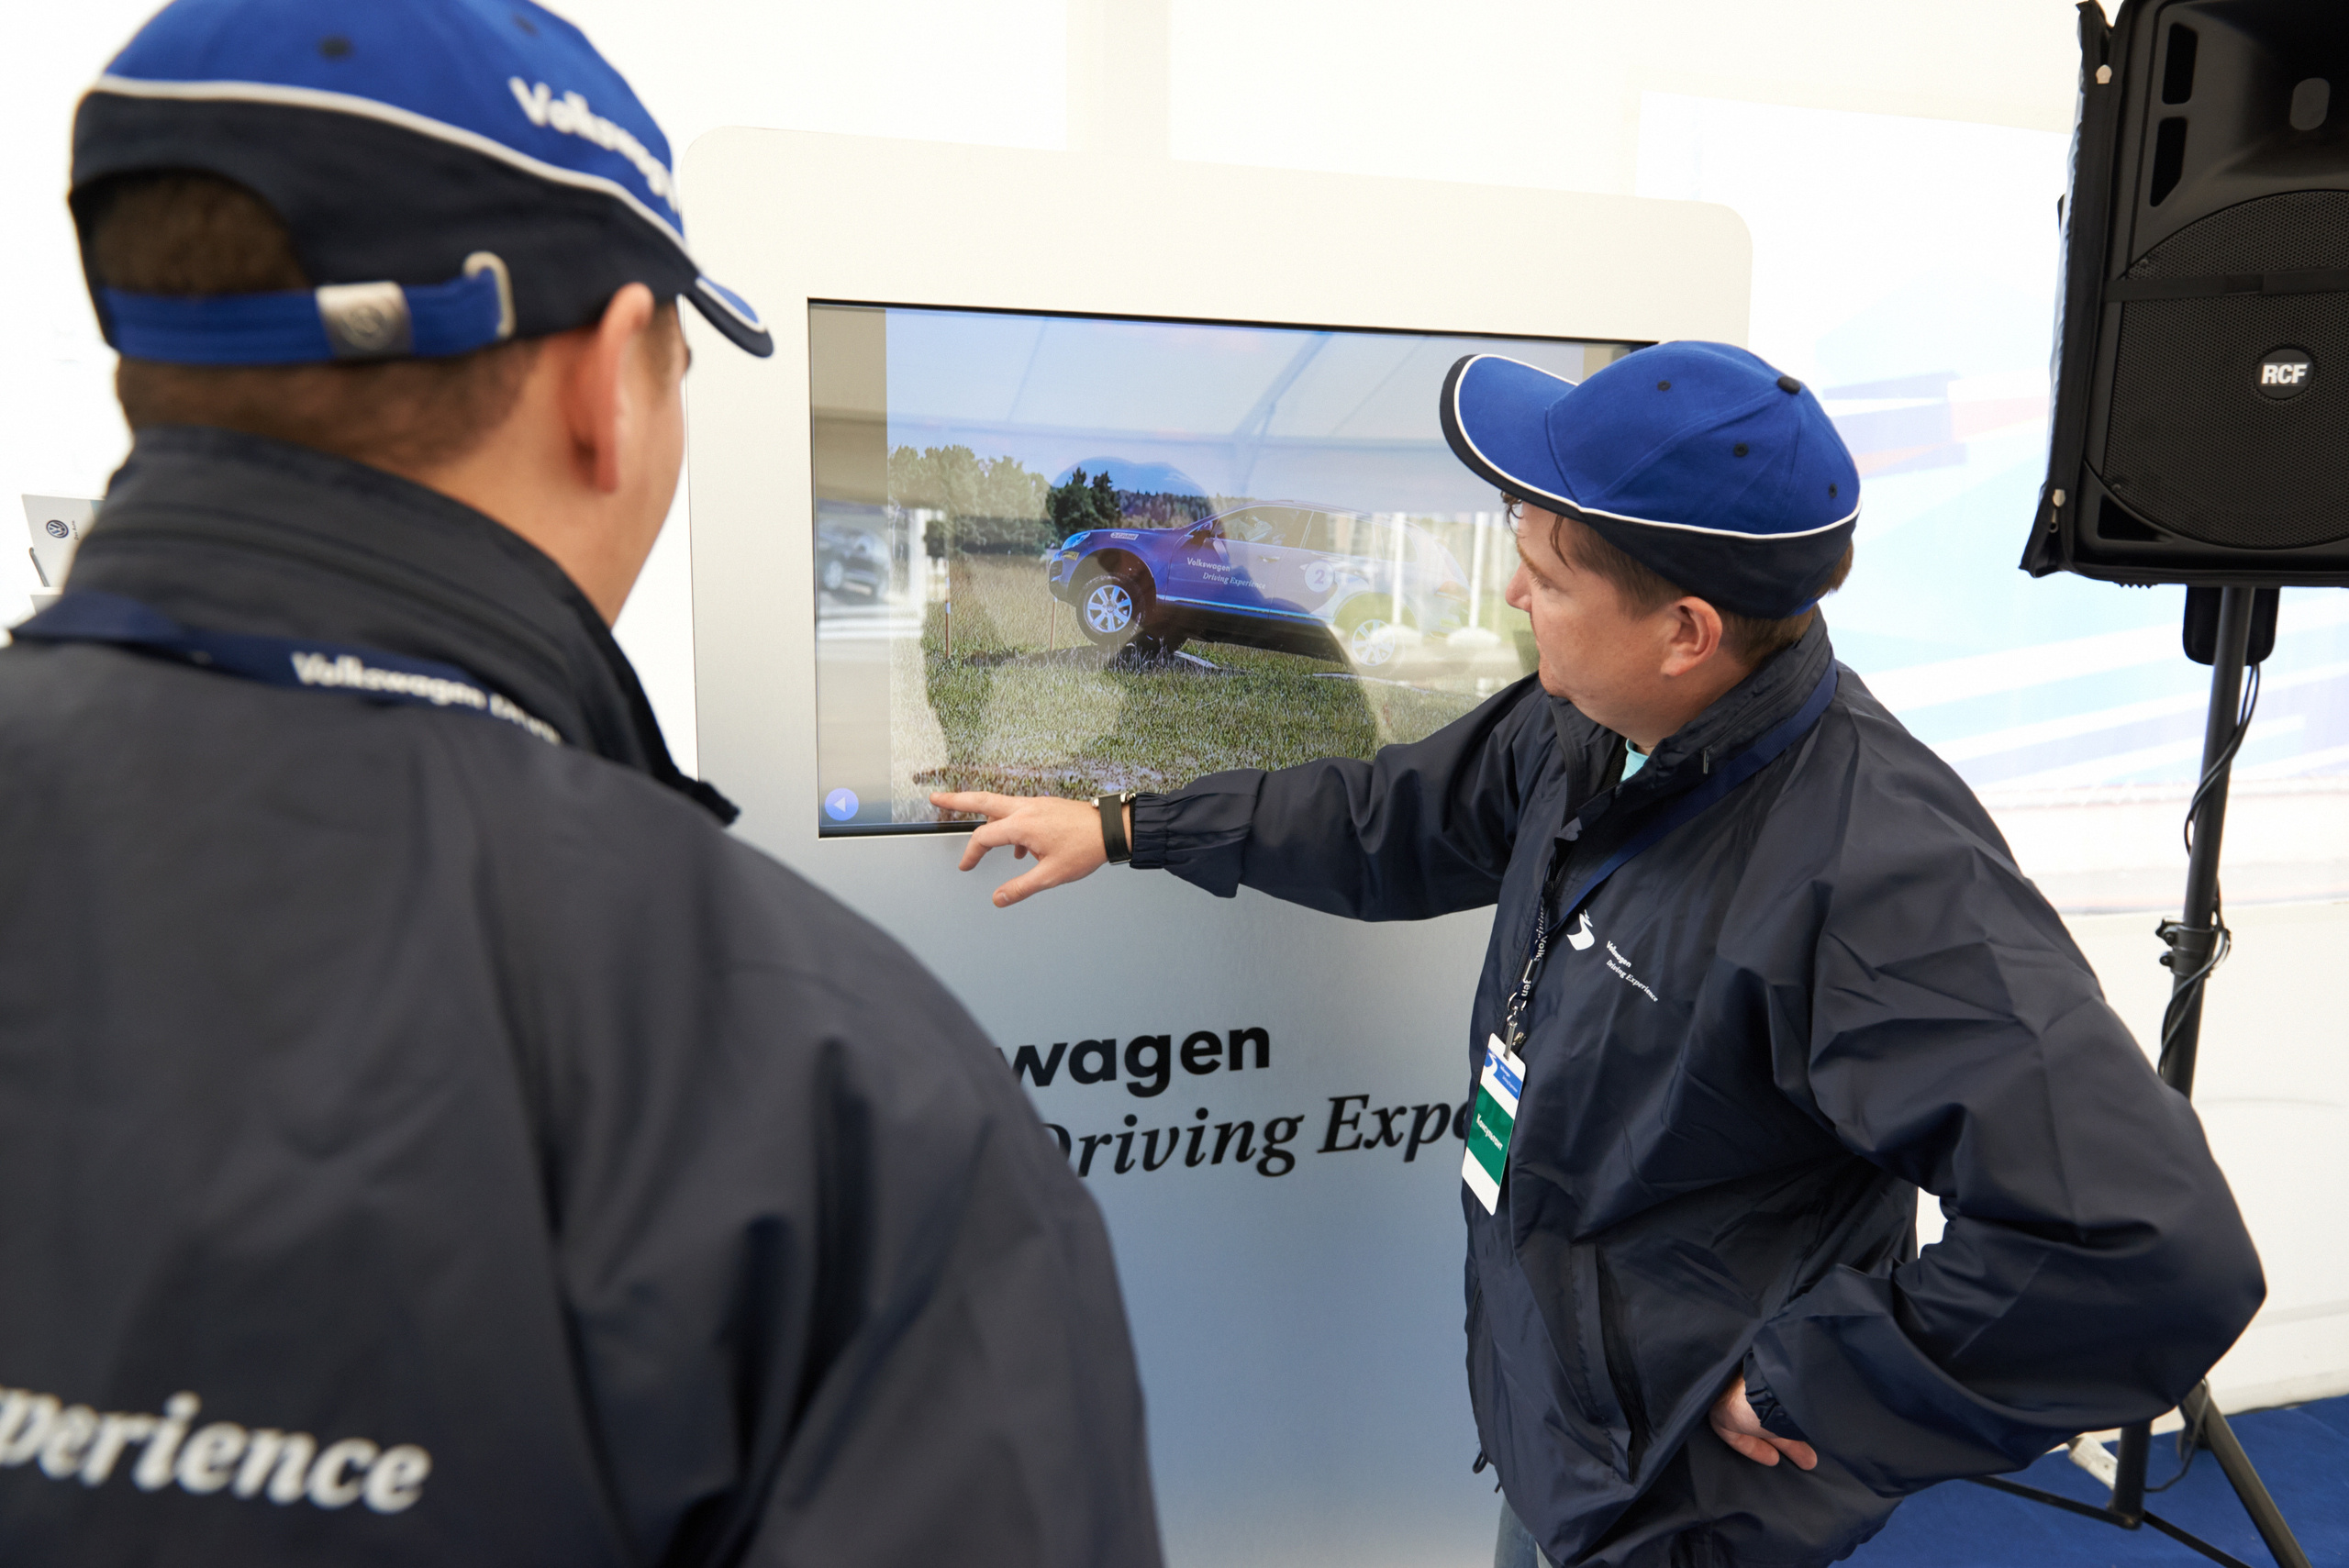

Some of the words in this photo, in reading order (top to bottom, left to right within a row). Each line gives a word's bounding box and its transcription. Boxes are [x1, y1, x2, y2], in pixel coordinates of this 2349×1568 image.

[2261, 364, 2308, 384] RCF
[1186, 557, 1230, 572] Volkswagen
[1202, 572, 1230, 584] Driving
[1230, 576, 1266, 589] Experience
[1314, 569, 1325, 584] 2
[291, 651, 487, 710] Volkswagen
[1606, 959, 1627, 979] Driving
[1625, 973, 1658, 1002] Experience
